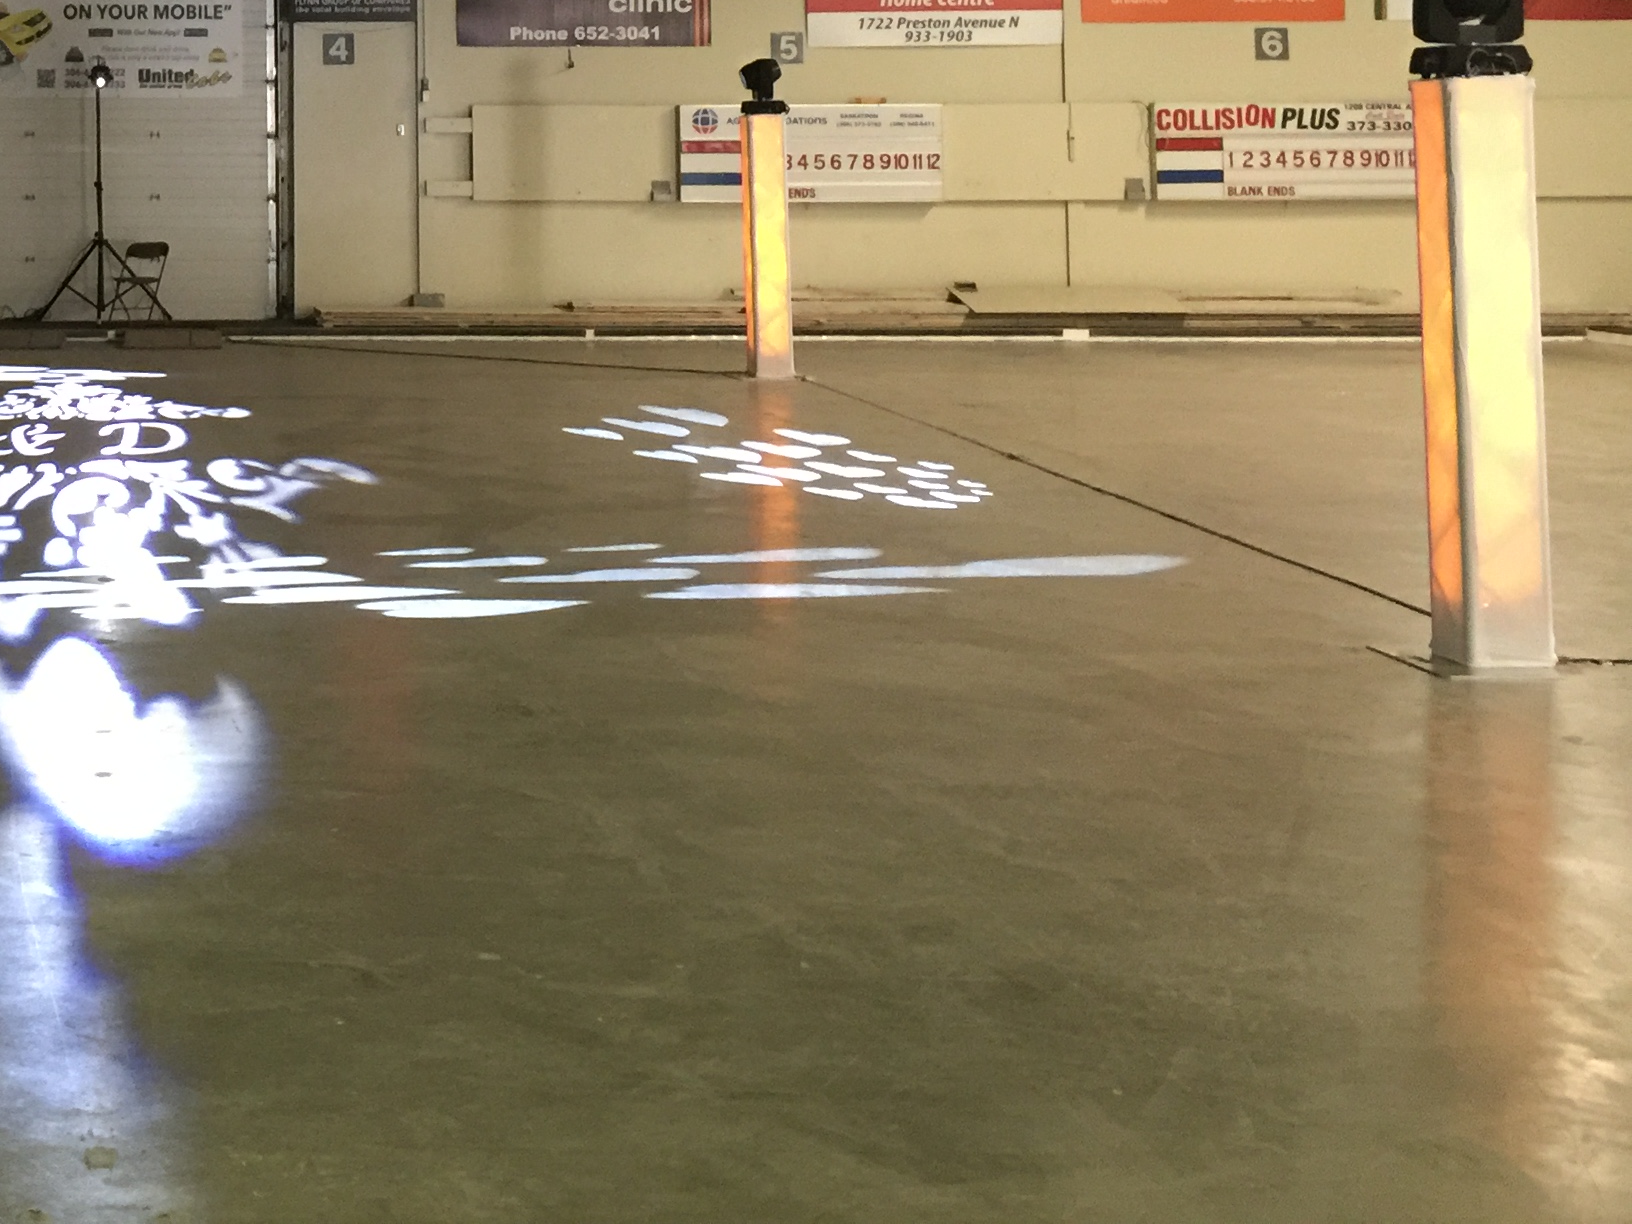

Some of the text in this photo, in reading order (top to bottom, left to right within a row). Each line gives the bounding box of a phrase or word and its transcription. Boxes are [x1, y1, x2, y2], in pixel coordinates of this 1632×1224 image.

[63, 4, 92, 20] ON
[97, 4, 148, 20] YOUR
[858, 16, 1019, 30] 1722 Preston Avenue N
[509, 26, 660, 41] Phone 652-3041
[904, 30, 973, 43] 933-1903
[329, 36, 348, 62] 4
[779, 36, 798, 60] 5
[1261, 30, 1283, 57] 6
[138, 68, 194, 83] United
[1156, 104, 1340, 131] COLLISION PLUS
[1347, 121, 1412, 131] 373-330
[788, 188, 816, 198] ENDS
[1227, 186, 1296, 197] BLANK ENDS
[99, 422, 189, 455] D
